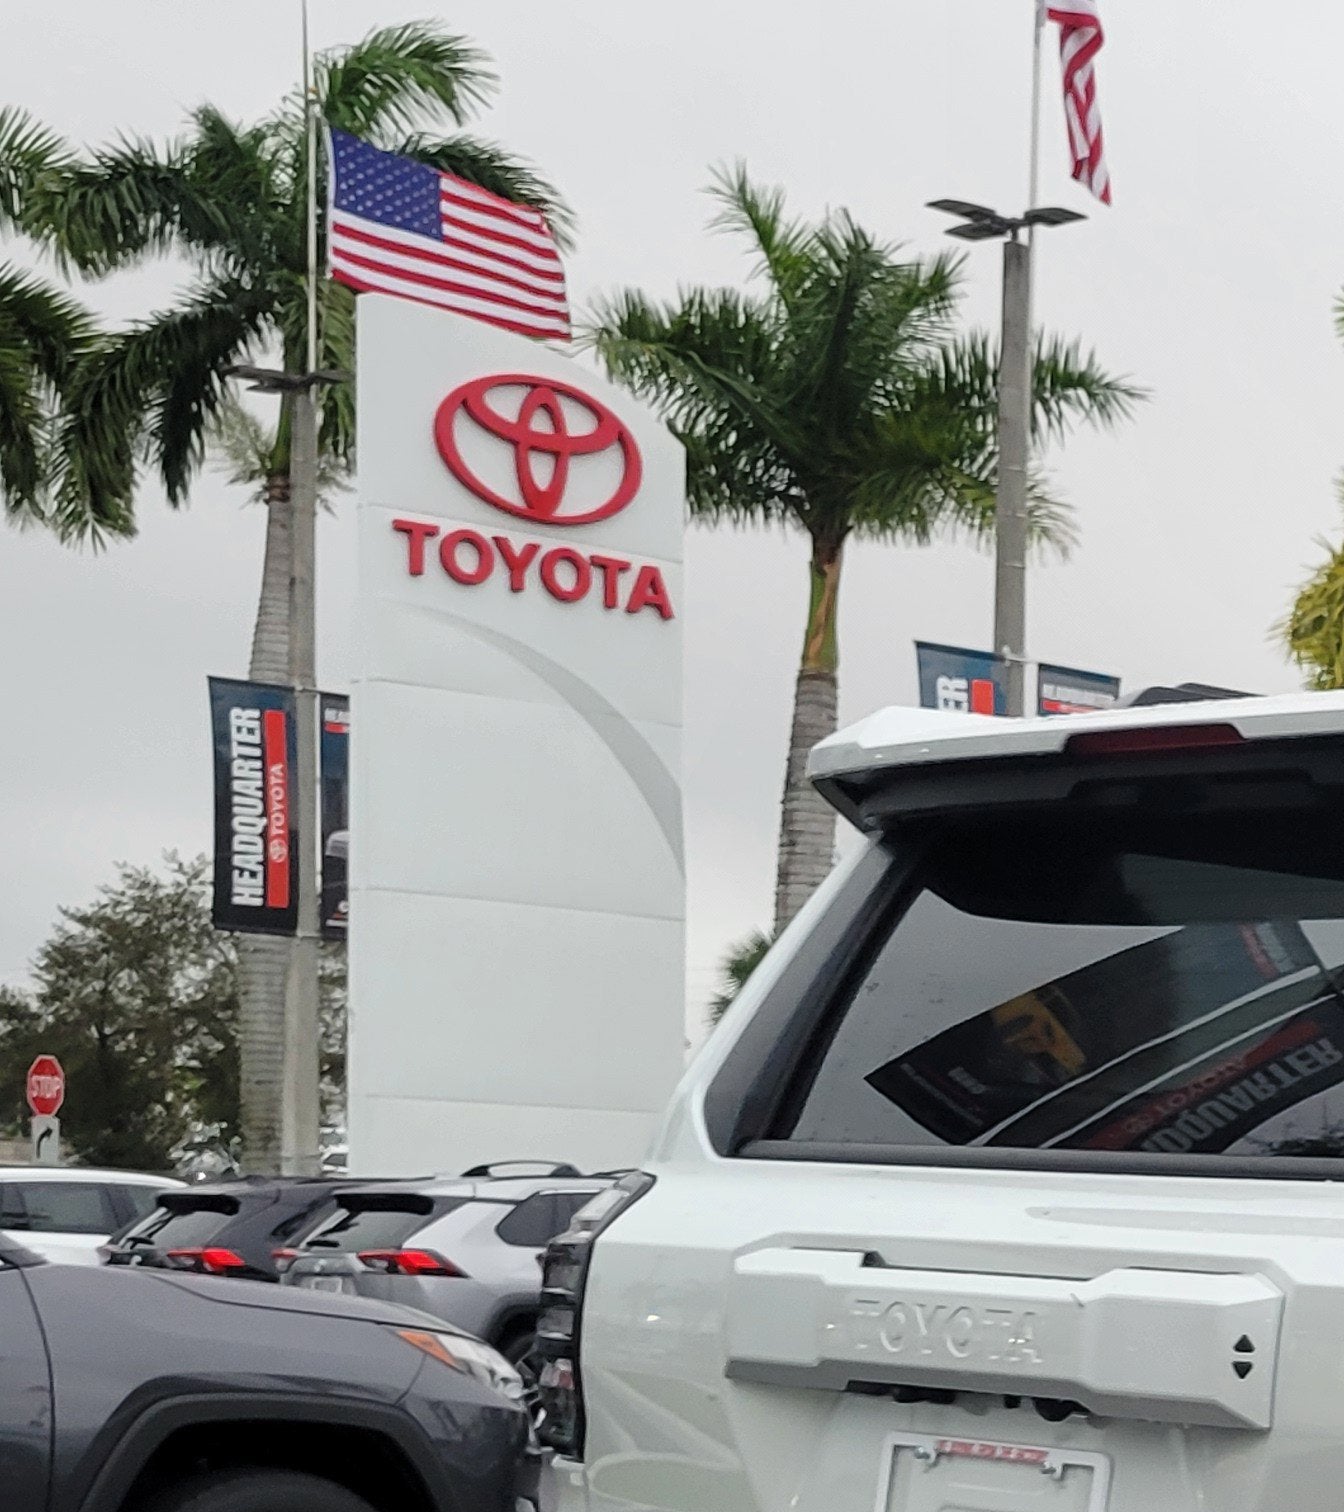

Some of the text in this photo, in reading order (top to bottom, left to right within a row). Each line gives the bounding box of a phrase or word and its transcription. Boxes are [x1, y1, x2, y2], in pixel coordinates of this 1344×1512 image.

[392, 518, 675, 620] TOYOTA
[229, 707, 267, 907] HEADQUARTER
[269, 763, 286, 835] TOYOTA
[31, 1075, 61, 1099] STOP
[853, 1299, 1044, 1364] TOYOTA
